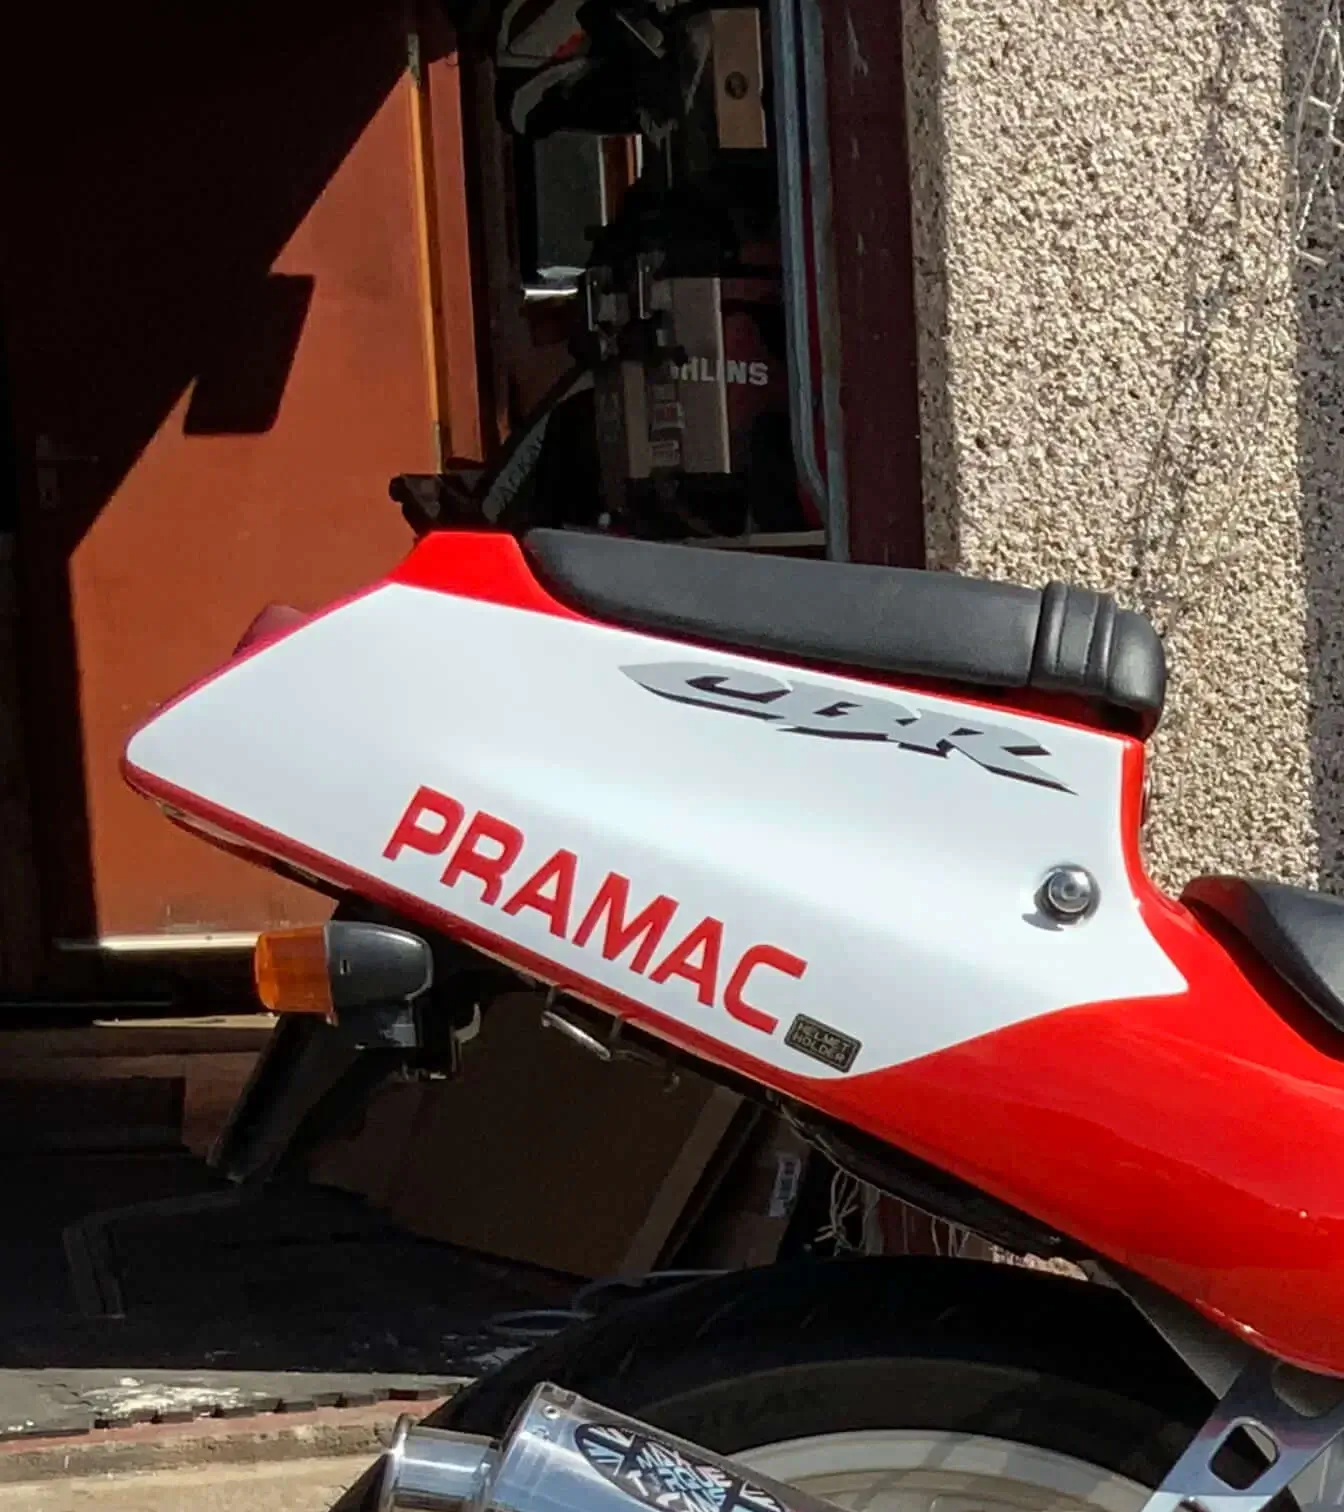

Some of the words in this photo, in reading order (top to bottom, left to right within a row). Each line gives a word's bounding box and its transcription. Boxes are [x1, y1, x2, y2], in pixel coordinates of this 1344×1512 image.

[669, 356, 769, 387] HLINS
[618, 661, 1079, 796] CBR
[383, 786, 808, 1035] PRAMAC
